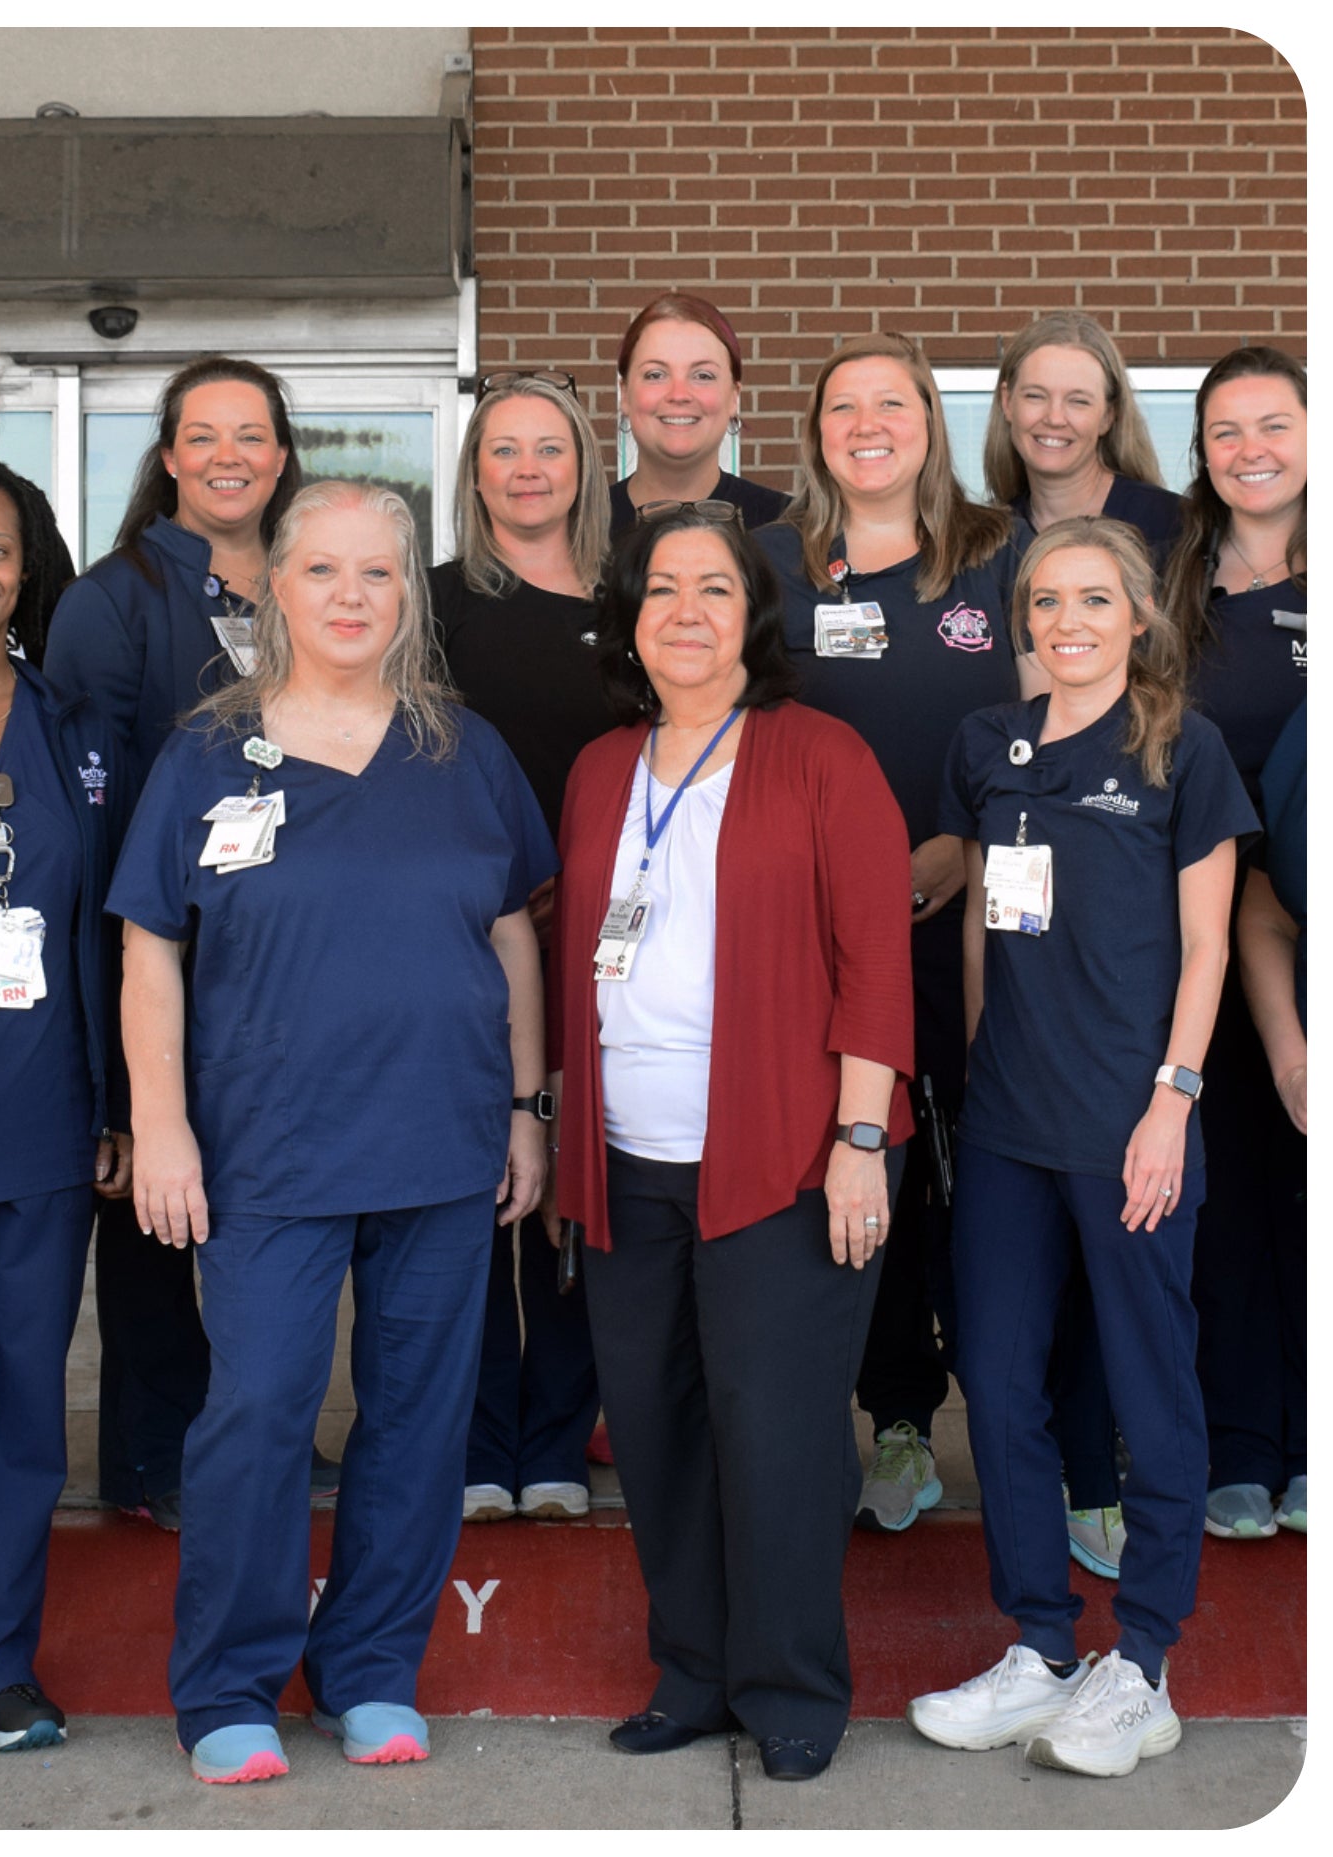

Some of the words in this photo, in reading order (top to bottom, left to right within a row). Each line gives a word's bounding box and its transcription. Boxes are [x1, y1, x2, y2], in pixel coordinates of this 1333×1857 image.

[220, 843, 240, 854] RN
[3, 986, 27, 1002] RN
[1110, 1699, 1152, 1734] HOKA
